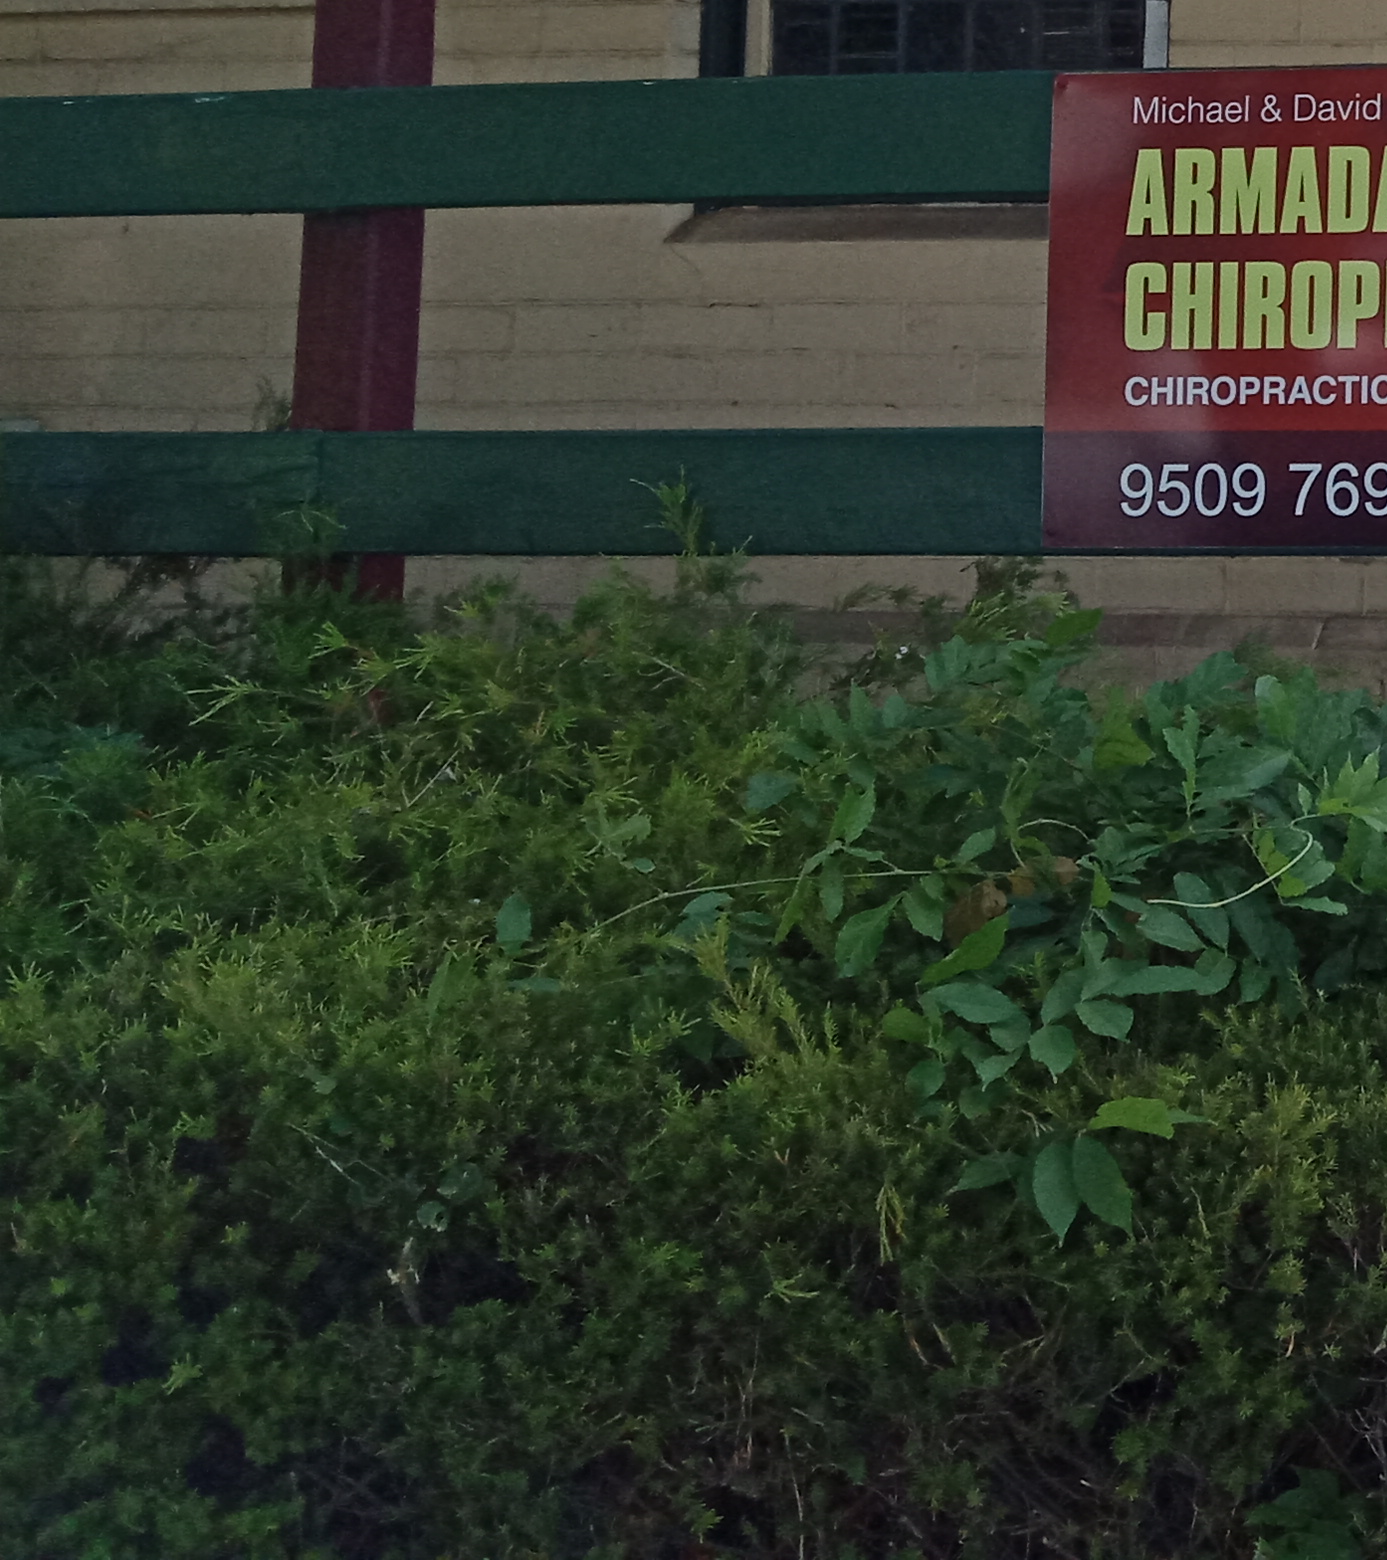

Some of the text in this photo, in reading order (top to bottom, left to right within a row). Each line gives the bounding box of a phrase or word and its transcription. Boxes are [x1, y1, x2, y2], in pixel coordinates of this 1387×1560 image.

[1132, 95, 1250, 125] Michael
[1260, 94, 1282, 123] &
[1293, 93, 1381, 122] David
[1119, 462, 1267, 518] 9509
